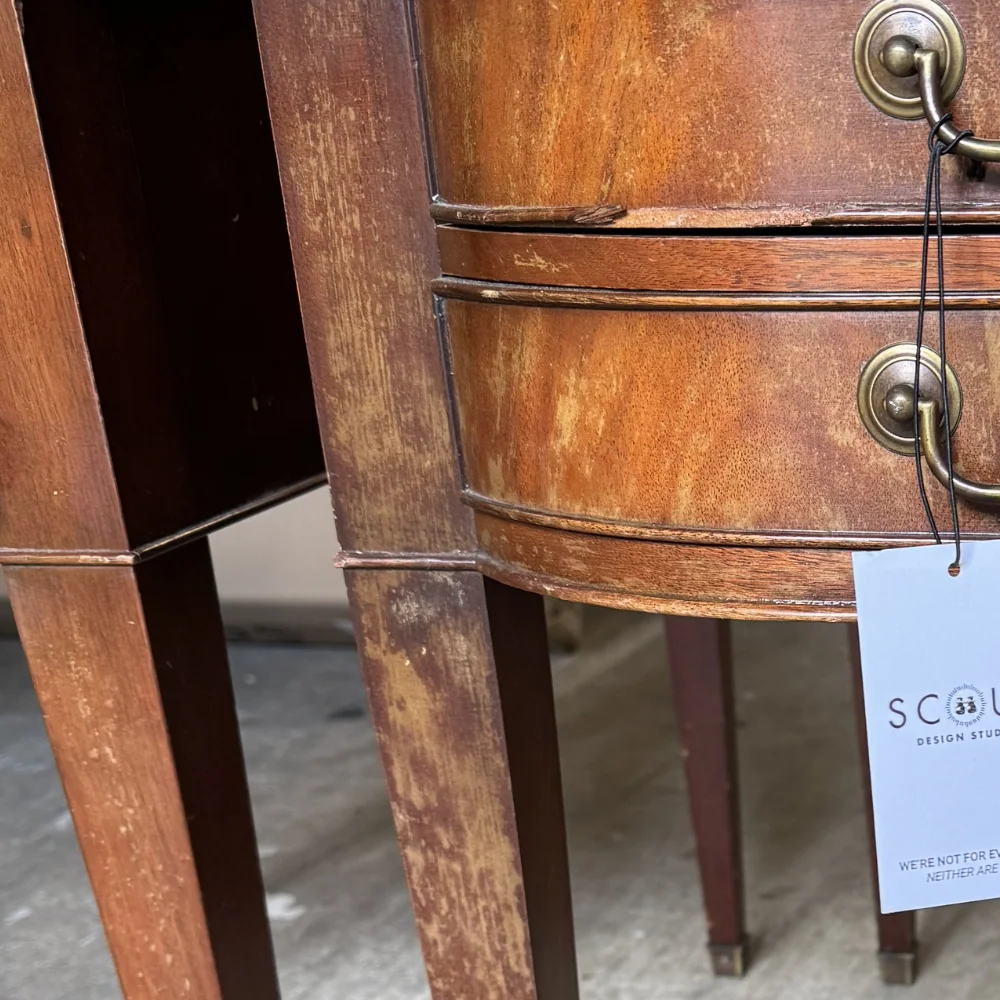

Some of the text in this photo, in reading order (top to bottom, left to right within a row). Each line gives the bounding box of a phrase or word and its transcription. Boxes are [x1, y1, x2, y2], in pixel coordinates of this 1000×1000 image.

[917, 732, 964, 746] DESIGN
[898, 857, 935, 871] WE'RE
[937, 854, 961, 866] NOT
[963, 850, 987, 863] FOR
[926, 866, 974, 882] NEITHER
[976, 863, 999, 876] ARE
